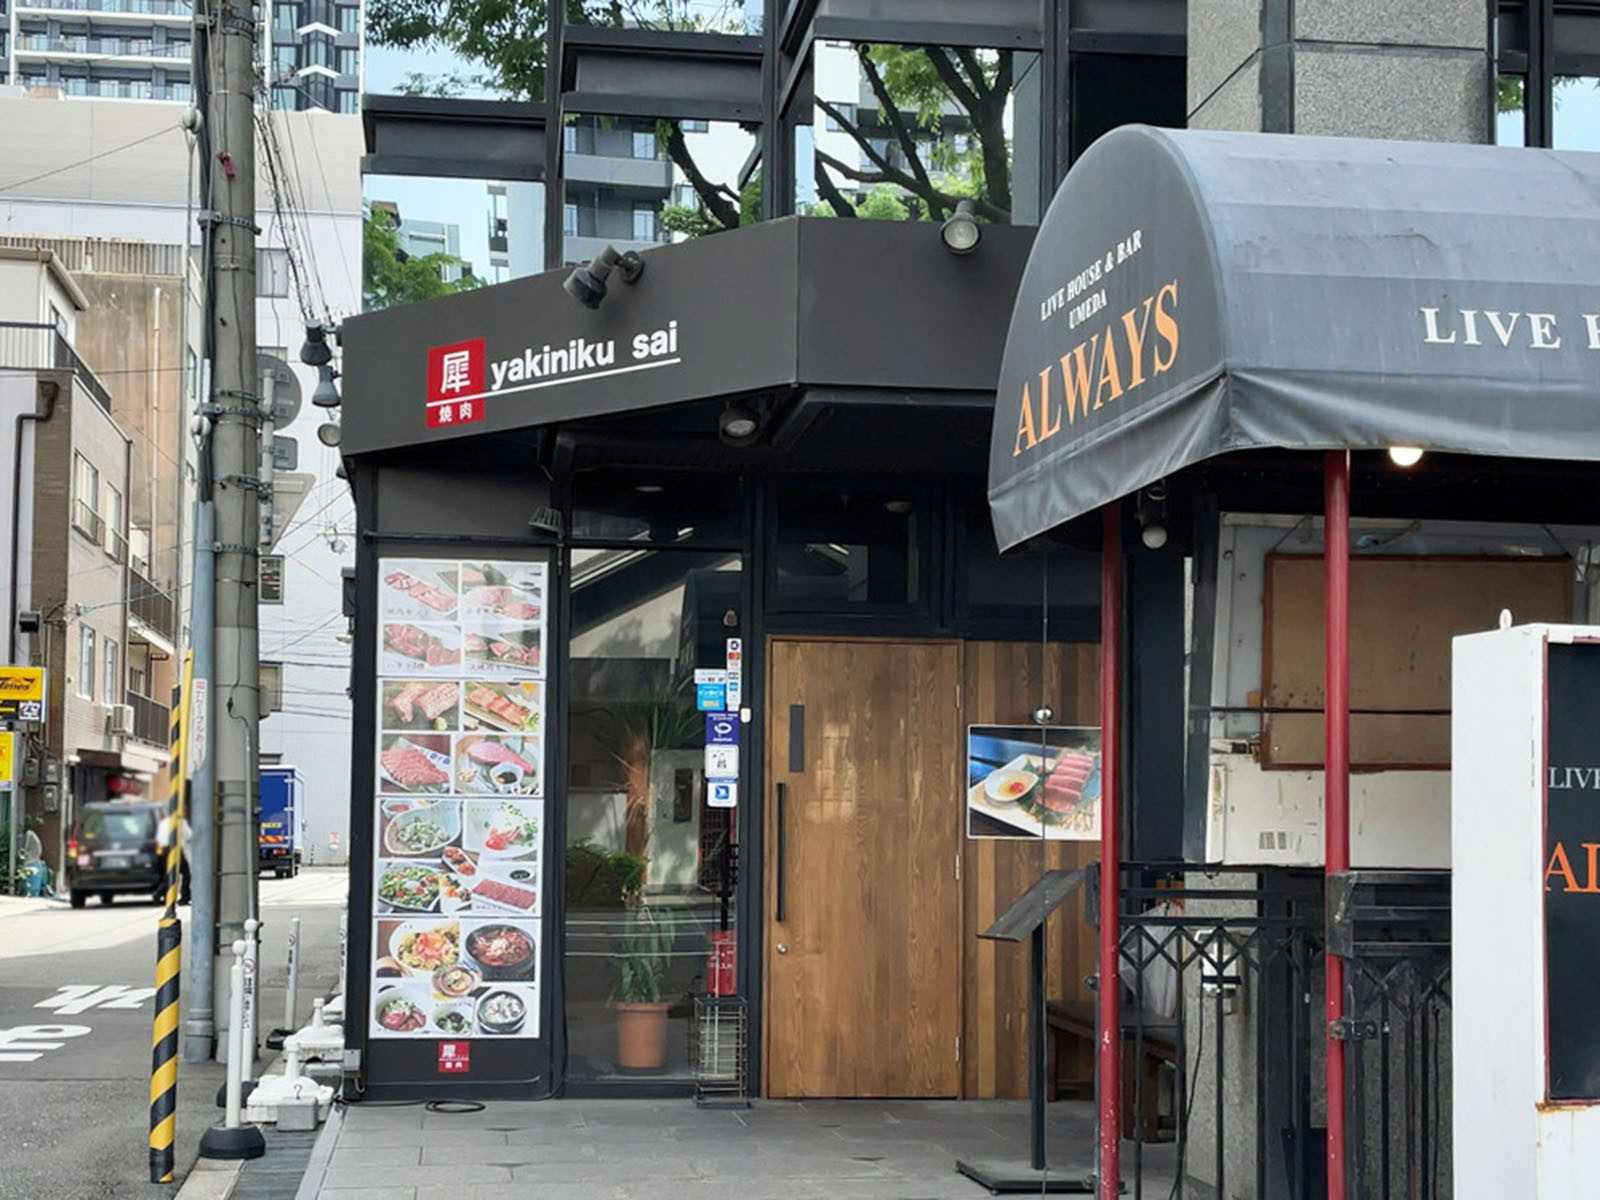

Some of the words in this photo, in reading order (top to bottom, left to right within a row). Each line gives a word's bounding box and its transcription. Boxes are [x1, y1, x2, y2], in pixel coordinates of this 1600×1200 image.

[1041, 288, 1065, 322] LIVE
[1067, 259, 1102, 302] HOUSE
[1104, 251, 1114, 274] &
[1117, 229, 1143, 265] BAR
[1068, 288, 1107, 330] UMEDA
[1420, 306, 1561, 350] LIVE
[440, 350, 471, 394] 犀
[490, 338, 615, 391] yakiniku
[632, 320, 678, 359] sai
[1012, 278, 1180, 457] ALWAYS
